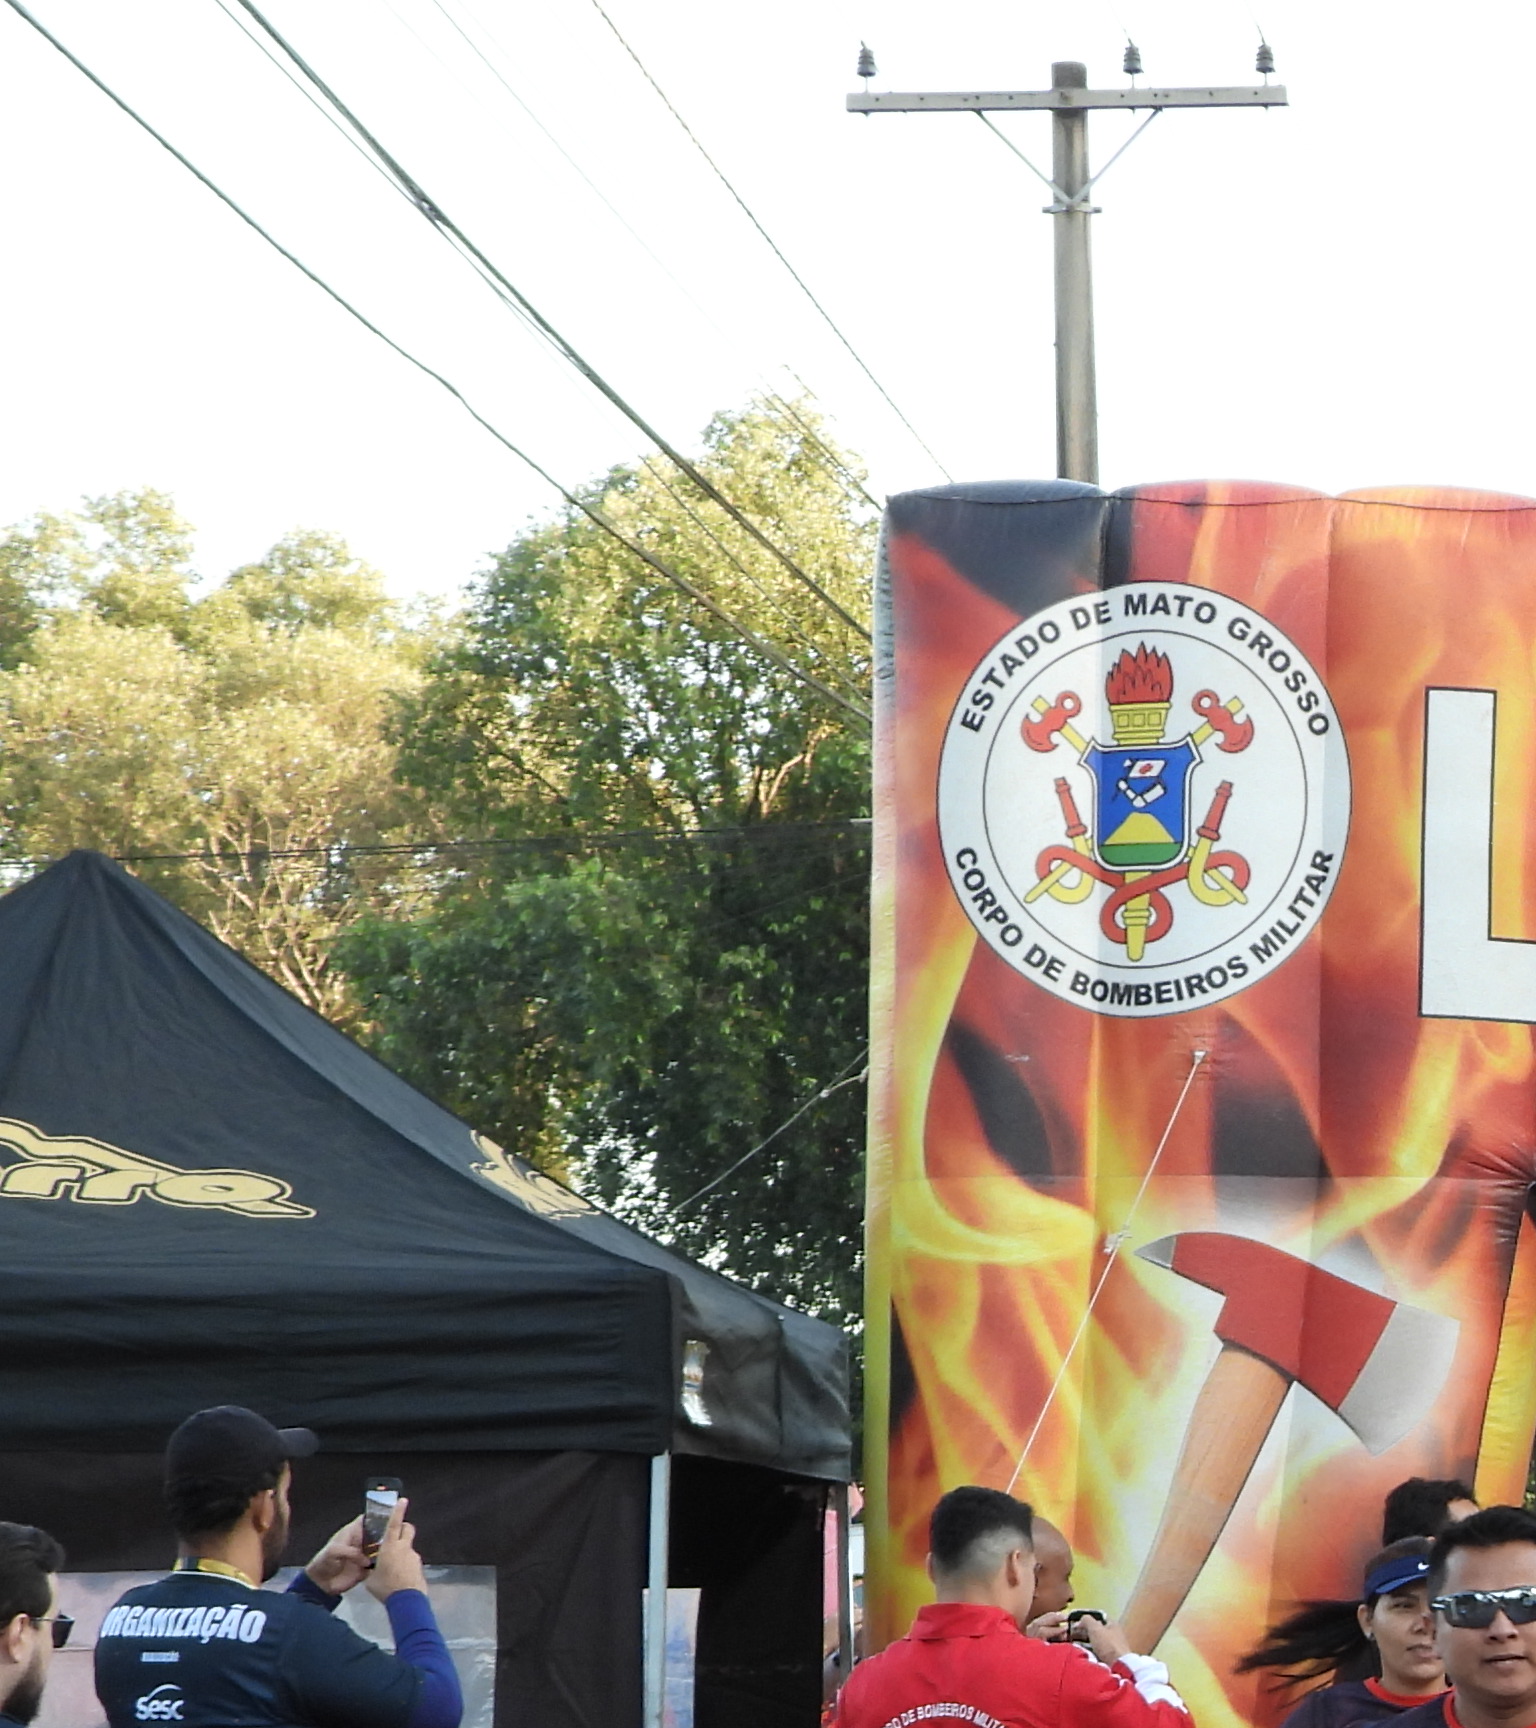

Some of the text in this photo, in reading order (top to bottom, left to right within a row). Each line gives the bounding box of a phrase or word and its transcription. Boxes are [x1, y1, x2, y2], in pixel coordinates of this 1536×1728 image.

[960, 594, 1330, 737] ESTADO DE MATO GROSSO
[956, 846, 1334, 1007] CORPO DE BOMBEIROS MILITAR
[100, 1604, 267, 1644] ORGANIZAÇÃO
[135, 1684, 184, 1720] Sesc
[900, 1709, 917, 1726] DE
[917, 1703, 975, 1720] BOMBEIROS
